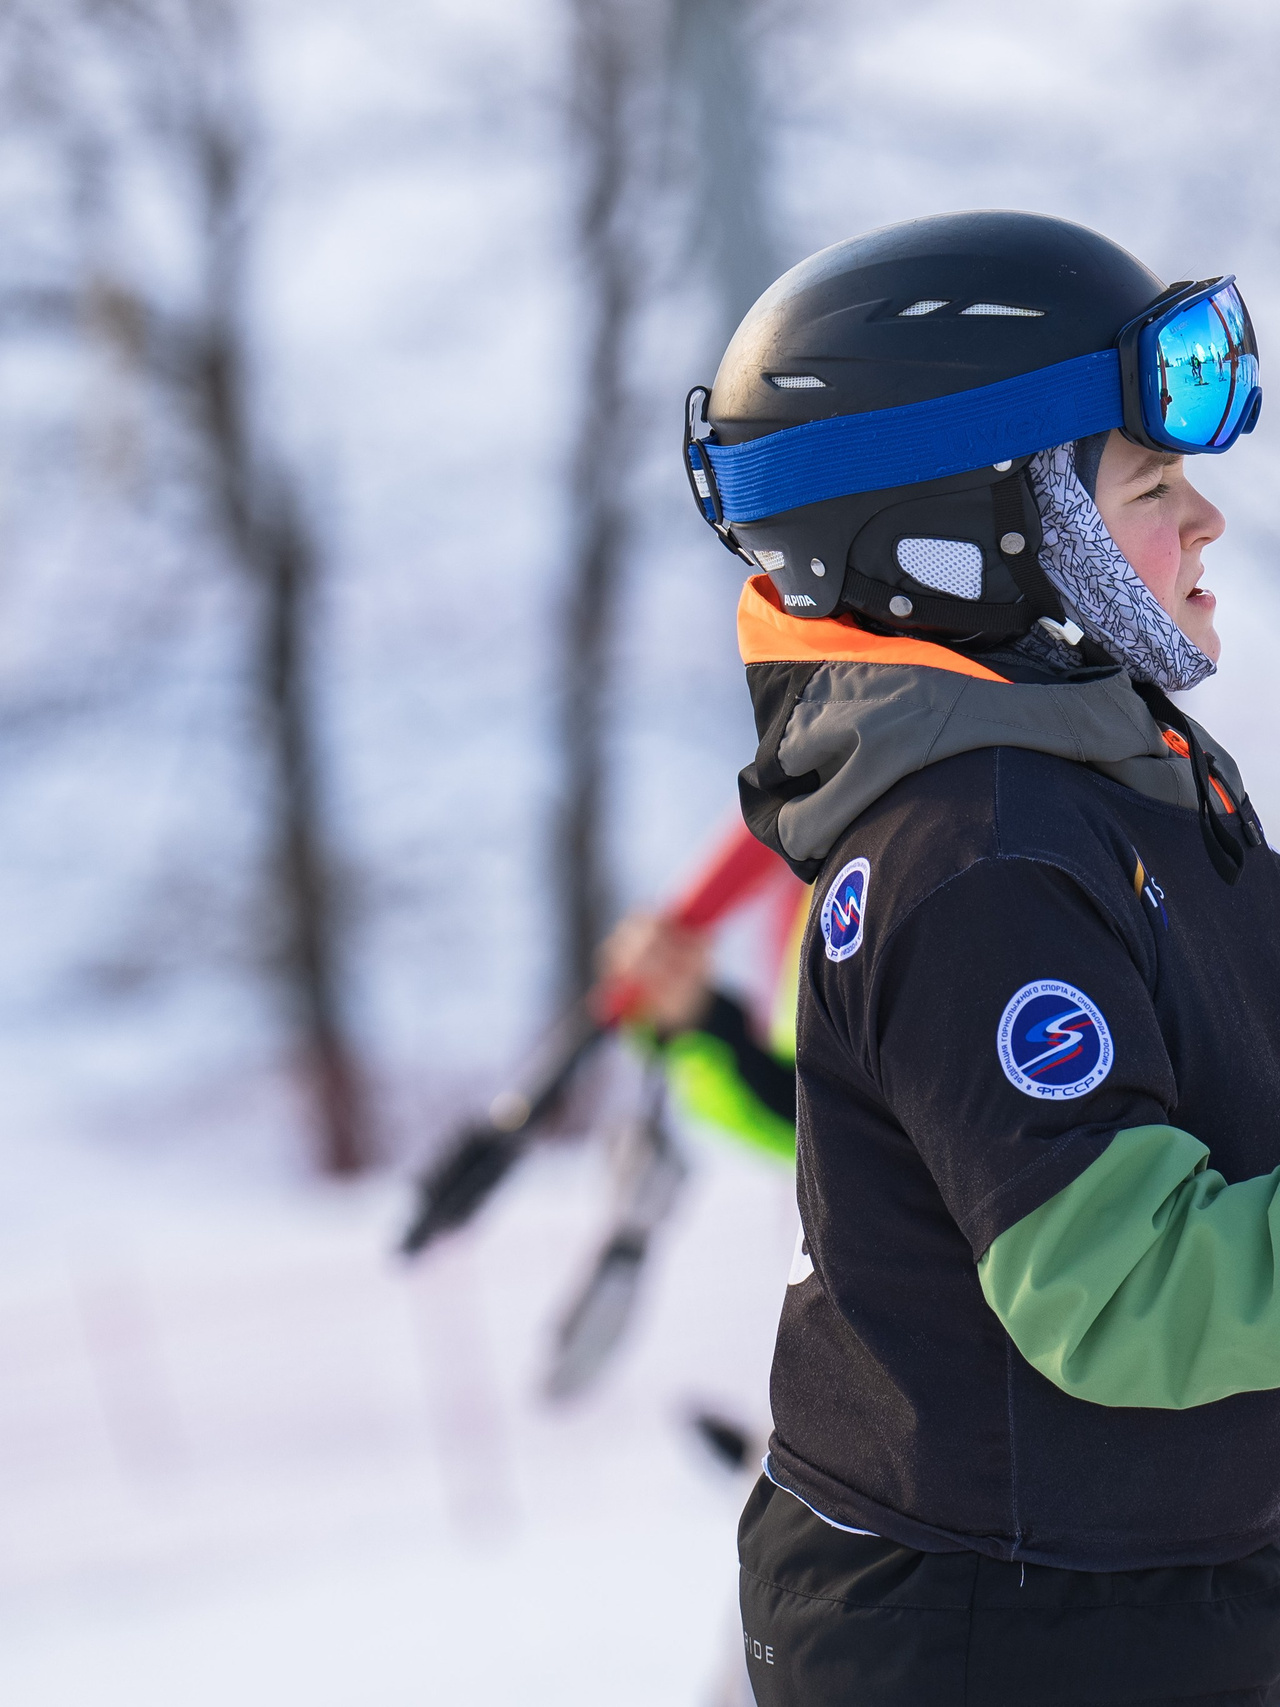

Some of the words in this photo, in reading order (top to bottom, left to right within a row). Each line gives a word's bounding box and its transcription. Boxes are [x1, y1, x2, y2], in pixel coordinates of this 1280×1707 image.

[784, 594, 817, 607] ALPINA
[1041, 984, 1068, 995] СПОРТА
[1070, 990, 1077, 999] И
[1001, 986, 1039, 1042] ГОРНОЛЫЖНОГО
[1077, 996, 1106, 1036] СНОУБОРДА
[1001, 1044, 1024, 1084] ФЕДЕРАЦИЯ
[1102, 1037, 1110, 1066] РОССИИ
[1036, 1076, 1095, 1097] ФГССР
